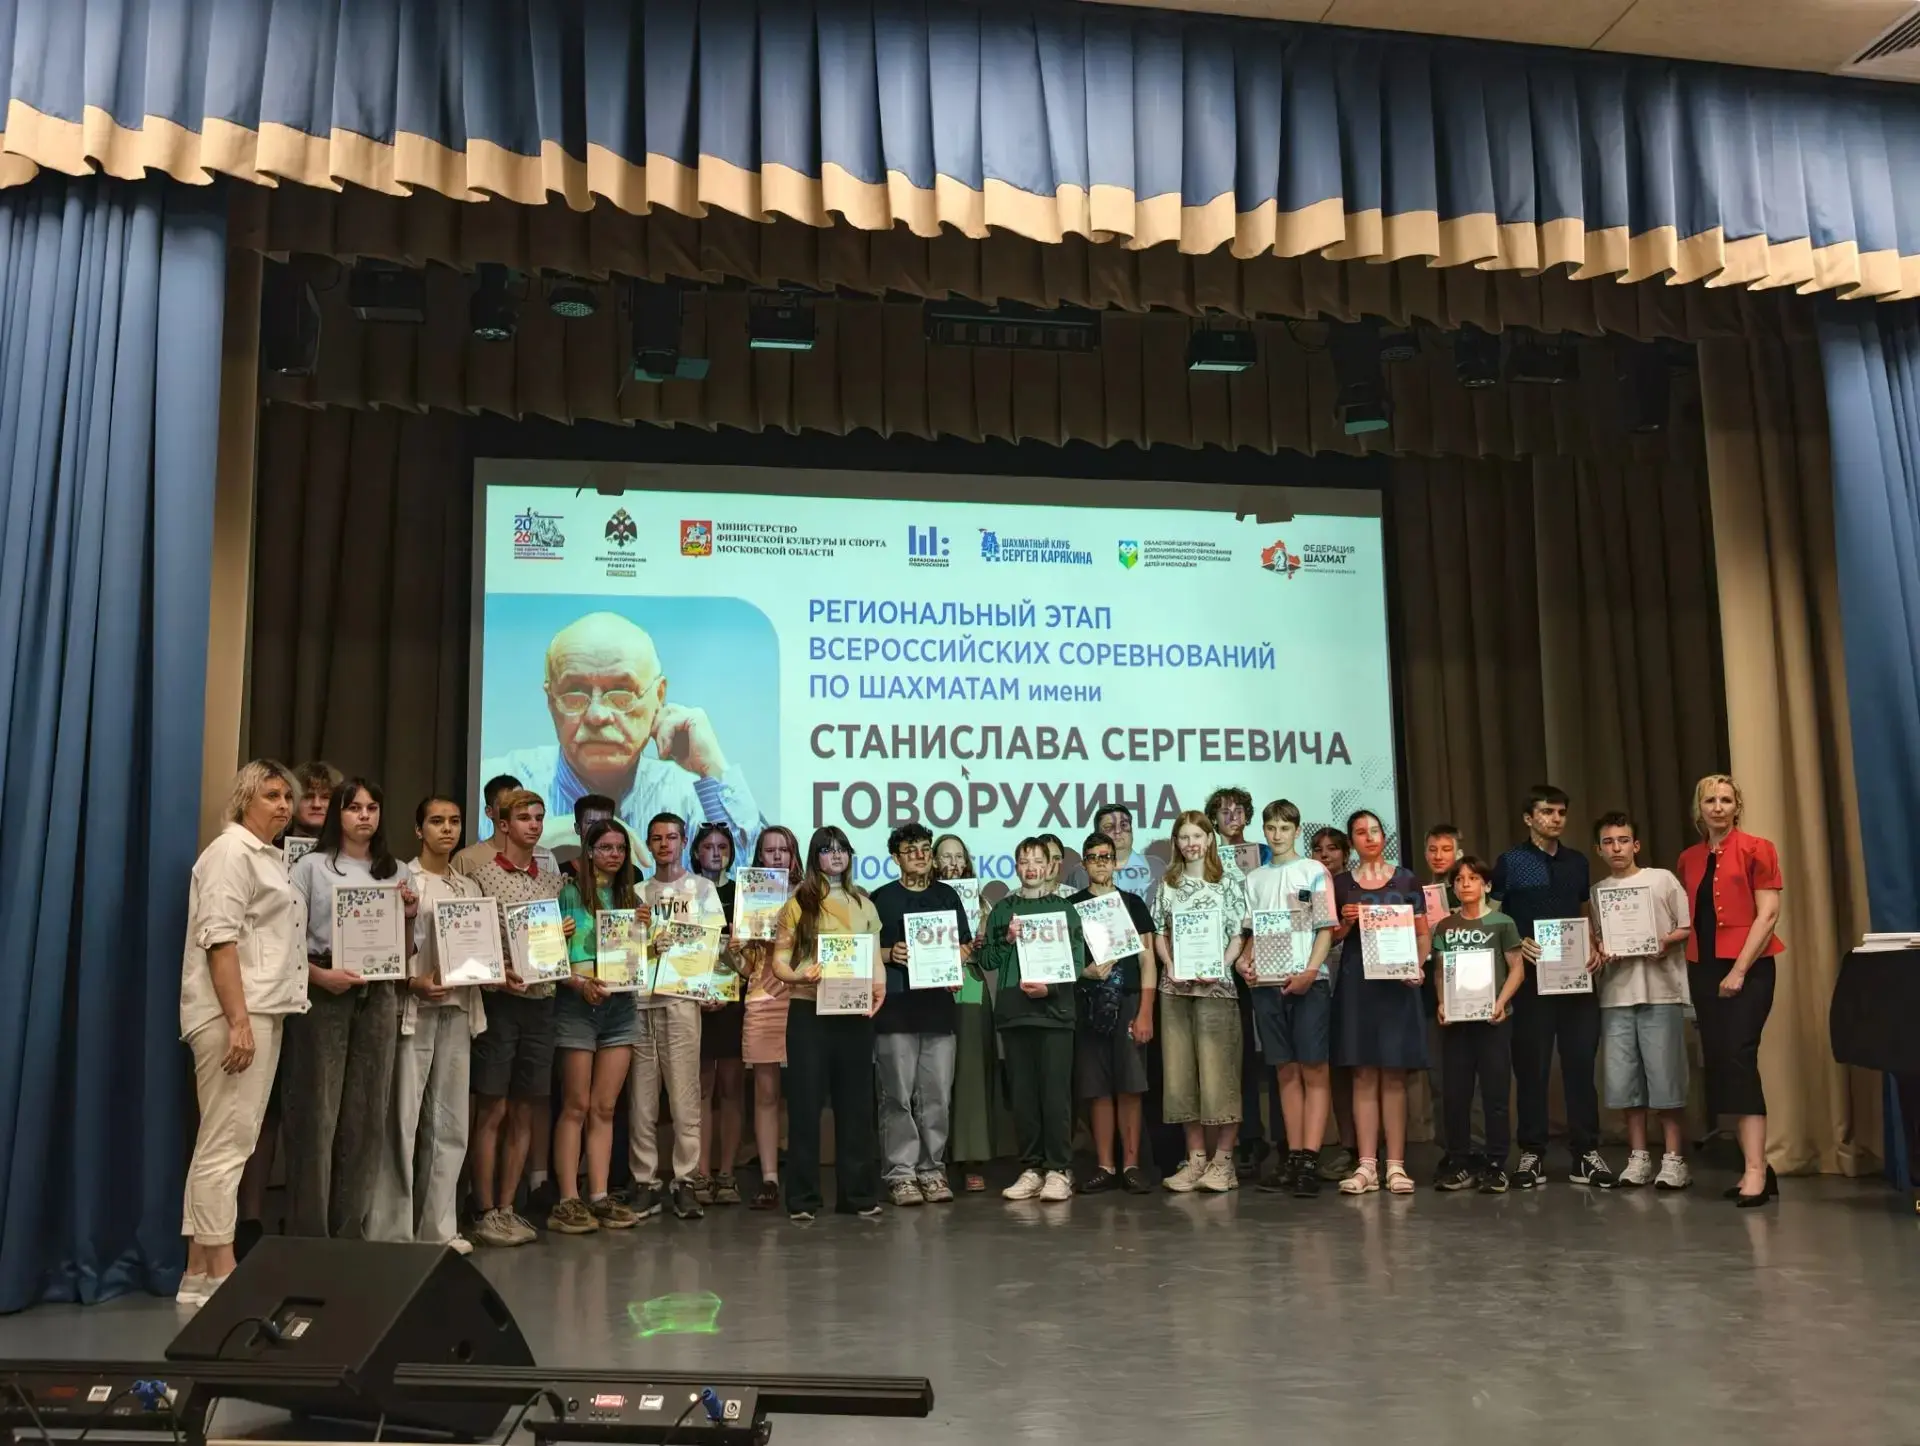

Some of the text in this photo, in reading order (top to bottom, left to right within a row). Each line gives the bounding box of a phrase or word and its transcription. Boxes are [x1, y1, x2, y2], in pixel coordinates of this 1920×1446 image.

[514, 518, 531, 530] 20
[716, 523, 797, 533] МИНИСТЕРСТВО
[514, 531, 531, 543] 26
[716, 534, 786, 545] ФИЗИЧЕСКОЙ
[787, 536, 838, 546] КУЛЬТУРЫ
[849, 539, 887, 548] СПОРТА
[1002, 538, 1071, 550] ШАХМАТНЫЙ КЛУБ
[716, 544, 834, 557] МОСКОВСКОЙ ОБЛАСТИ
[1303, 544, 1356, 554] ФЕДЕРАЦИЯ
[1002, 549, 1093, 565] СЕРГЕЯ КАРЯКИНА
[1303, 554, 1347, 564] ШАХМАТ
[809, 598, 1111, 629] РЕГИОНАЛЬНЫЙ ЭТАП
[809, 634, 1276, 669] ВСЕРОССИЙСКИХ СОРЕВНОВАНИЙ
[809, 674, 1102, 702] ПО ШАХМАТАМ имени
[810, 723, 1353, 765] СТАНИСЛАВА СЕРГЕЕВИЧА
[812, 781, 1182, 829] ГОВОРУХИНА
[1445, 928, 1494, 944] ENJOY
